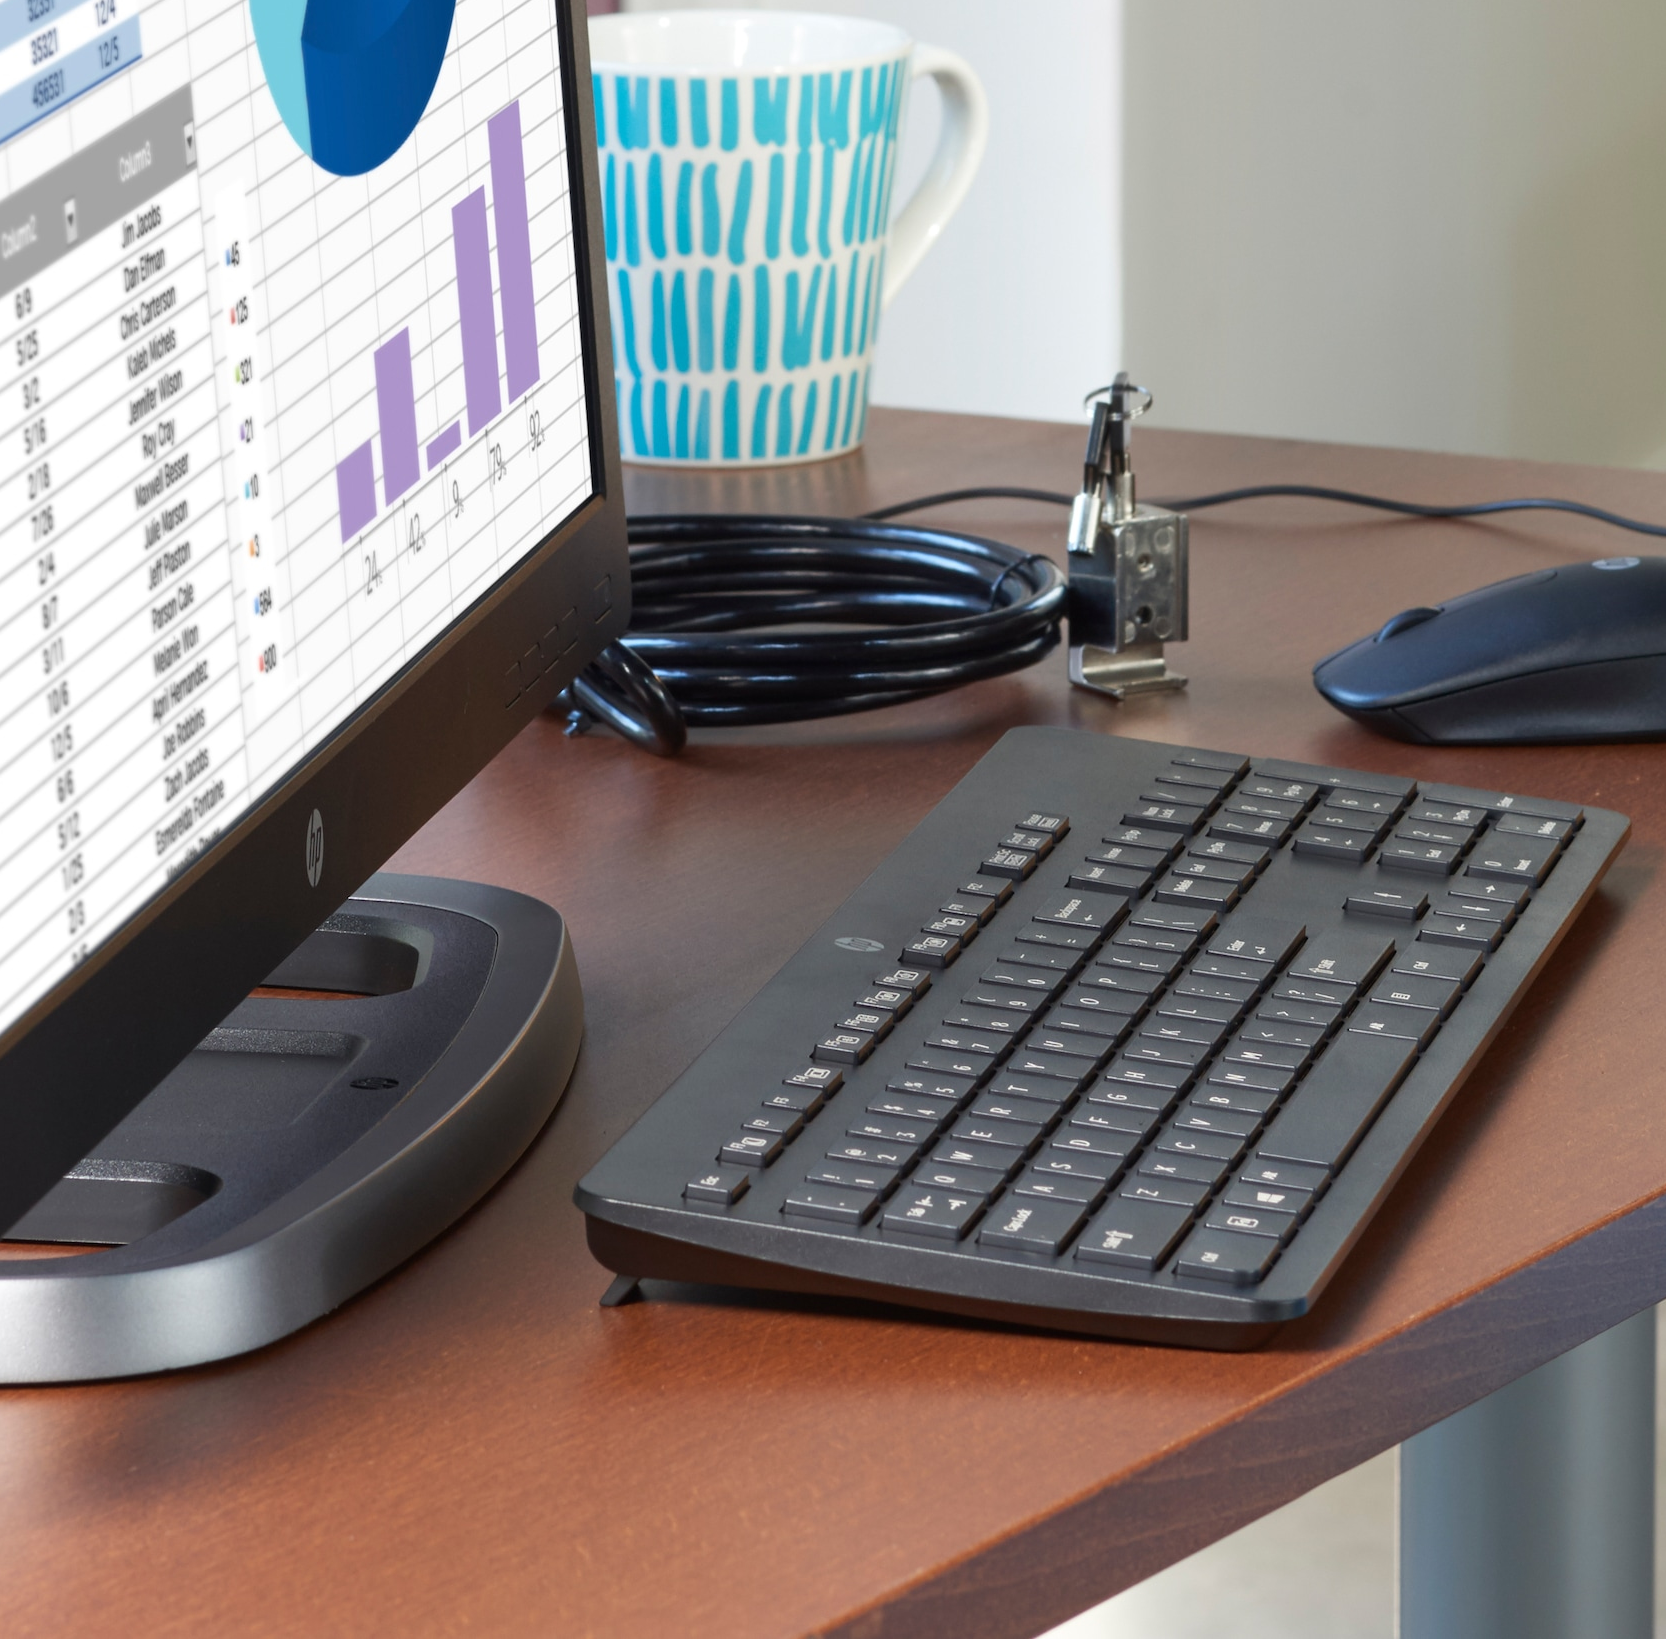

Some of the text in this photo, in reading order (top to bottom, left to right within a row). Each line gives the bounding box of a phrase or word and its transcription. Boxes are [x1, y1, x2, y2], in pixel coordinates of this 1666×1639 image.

[30, 28, 59, 65] 35321
[32, 69, 65, 108] 456531
[98, 36, 120, 70] 12/5
[1, 215, 38, 260] Column2
[119, 140, 152, 183] Column3
[122, 206, 161, 248] Jim Jacobs
[124, 249, 165, 292] Dan Elfman
[231, 241, 240, 267] 45
[121, 286, 176, 340] Chris Carterson
[236, 296, 248, 325] 125
[128, 328, 176, 378] Kaleb Michels
[240, 356, 253, 385] 321
[129, 370, 182, 425] Jennifer Wilson
[142, 420, 174, 458] Roy Cray
[245, 416, 254, 444] 21
[135, 454, 188, 508] Maxwell Besser
[250, 473, 259, 500] 10
[145, 500, 188, 550] Julie Marson
[254, 534, 260, 557] 3
[152, 584, 194, 631] Parson Cale
[259, 586, 272, 617] 564
[154, 625, 198, 674] Melanie Won
[263, 643, 277, 674] 900
[153, 660, 208, 722] April Hernandez
[163, 709, 205, 760] Joe Robbins
[165, 749, 209, 802] Zach Jacobs
[306, 809, 324, 888] hp
[1055, 900, 1081, 918] Backspace
[1125, 1071, 1145, 1079] H
[971, 1130, 992, 1138] E
[950, 1151, 973, 1160] W
[1051, 1162, 1071, 1170] S
[1154, 1165, 1176, 1173] X
[1033, 1184, 1054, 1193] A
[1137, 1188, 1158, 1196] Z
